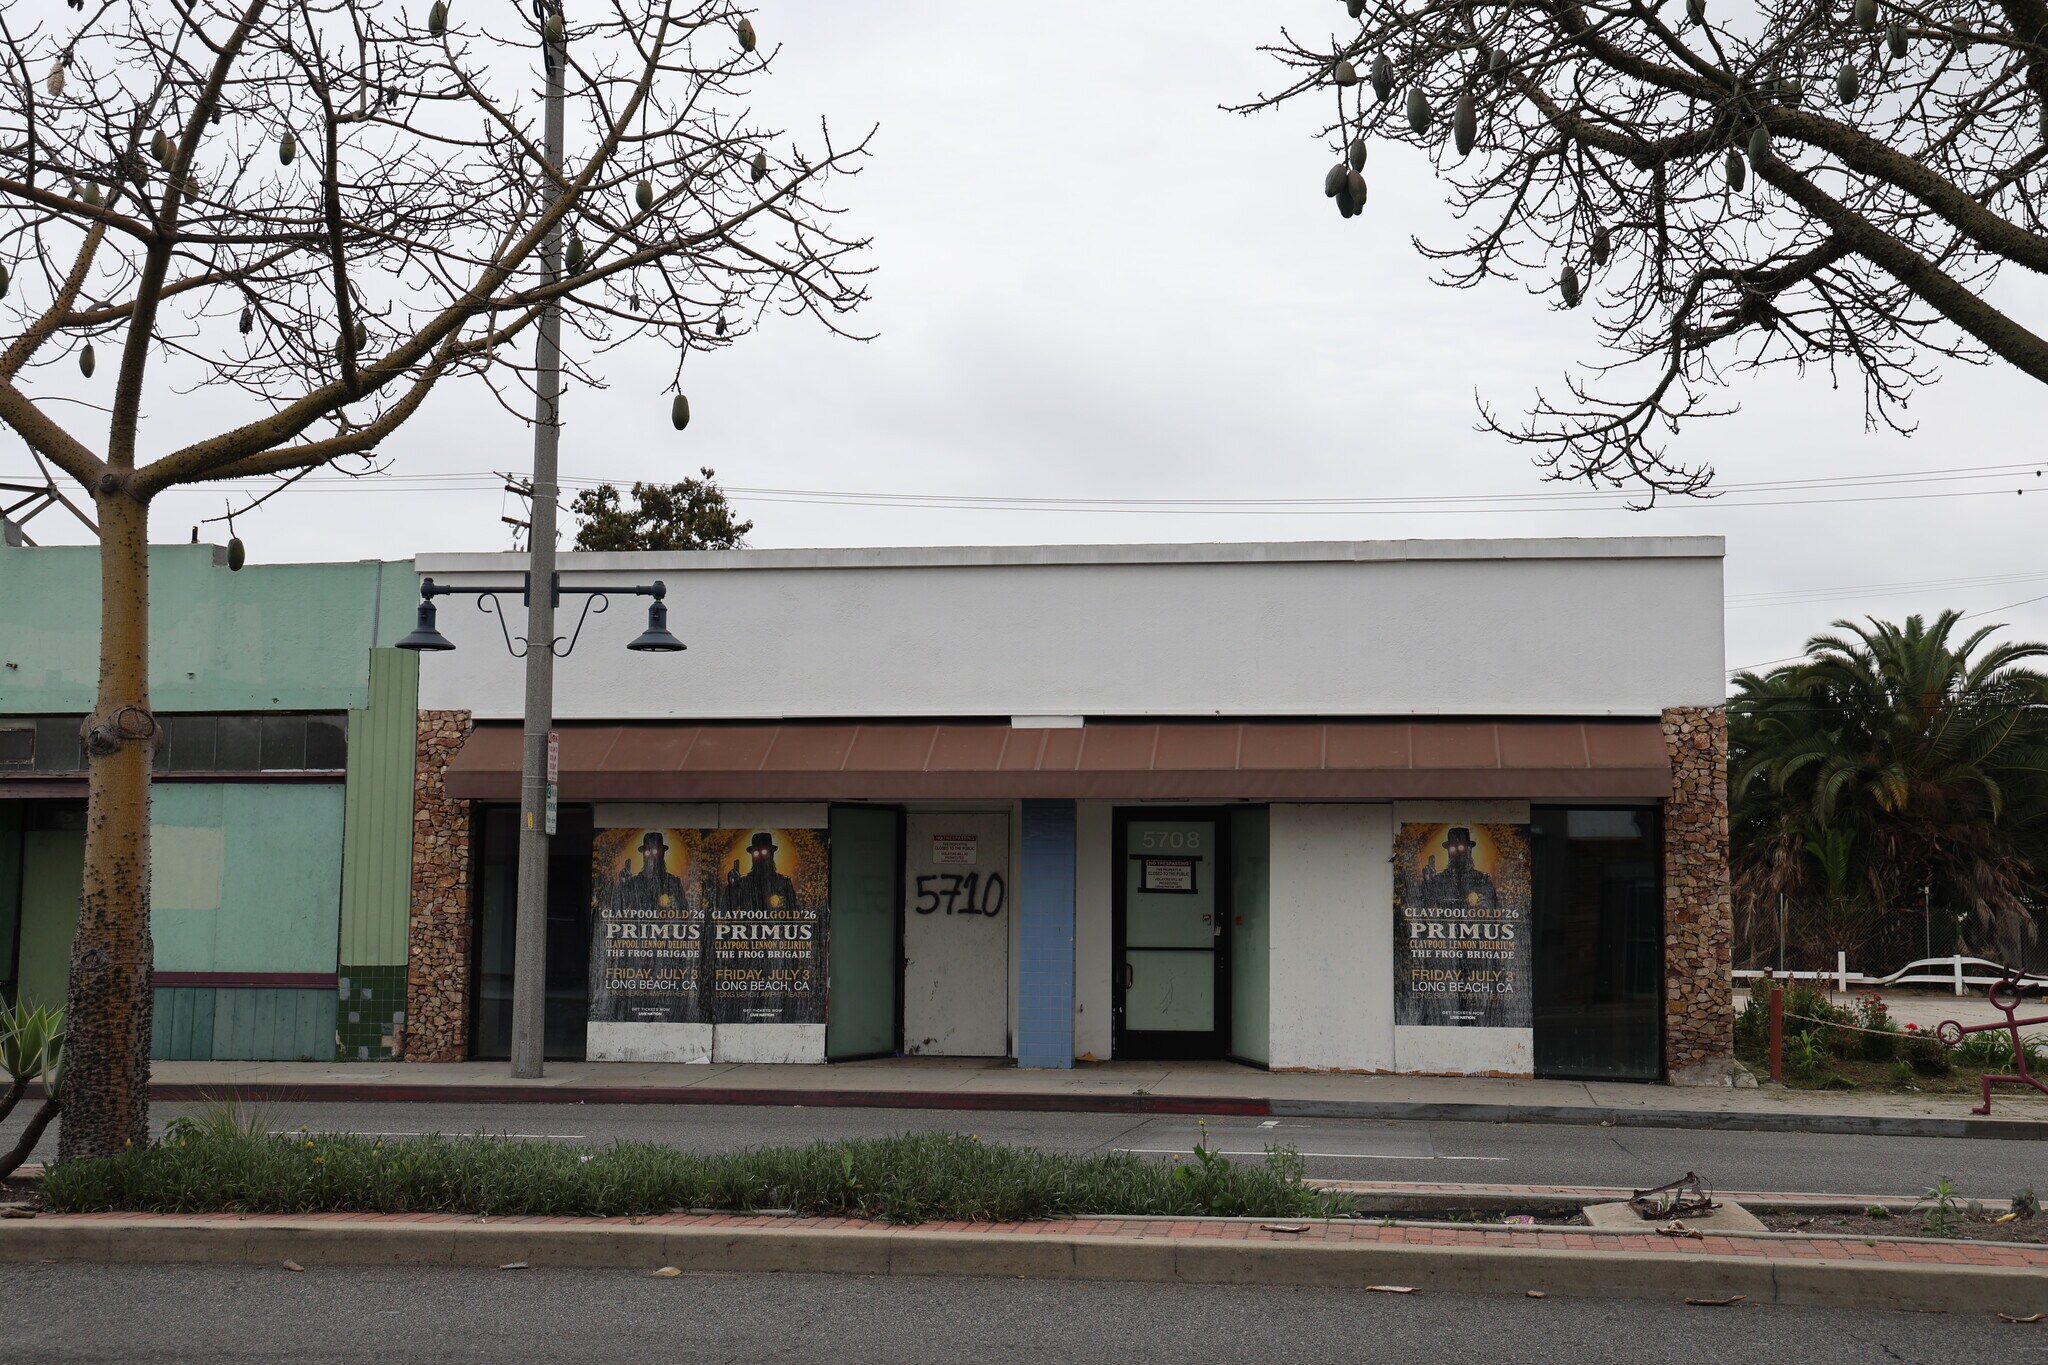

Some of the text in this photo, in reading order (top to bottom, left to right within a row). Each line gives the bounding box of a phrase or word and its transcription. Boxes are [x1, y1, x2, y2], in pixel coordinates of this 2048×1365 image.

[1142, 831, 1200, 849] 5708
[915, 871, 1005, 918] 5710
[606, 923, 701, 939] PRIMUS
[715, 924, 812, 940] PRIMUS
[1409, 922, 1515, 940] PRIMUS
[605, 939, 700, 949] CLAYPOOL LENNON DELIRIUM
[715, 940, 812, 950] CLAYPOOL LENNON DELIRIUM
[1409, 939, 1515, 950] CLAYPOOL LENNON DELIRIUM
[606, 949, 700, 958] THE FROG BRIGADE
[715, 950, 812, 959] THE FROG BRIGADE
[1411, 949, 1515, 960] THE FROG BRIGADE
[605, 968, 698, 980] FRIDAY, JULY 3
[715, 969, 810, 981] FRIDAY, JULY 3
[1412, 969, 1514, 982] FRIDAY, JULY 3
[605, 979, 698, 991] LONG BEACH, CA
[715, 980, 810, 992] LONG BEACH, CA
[1412, 981, 1514, 993] LONG BEACH, CA
